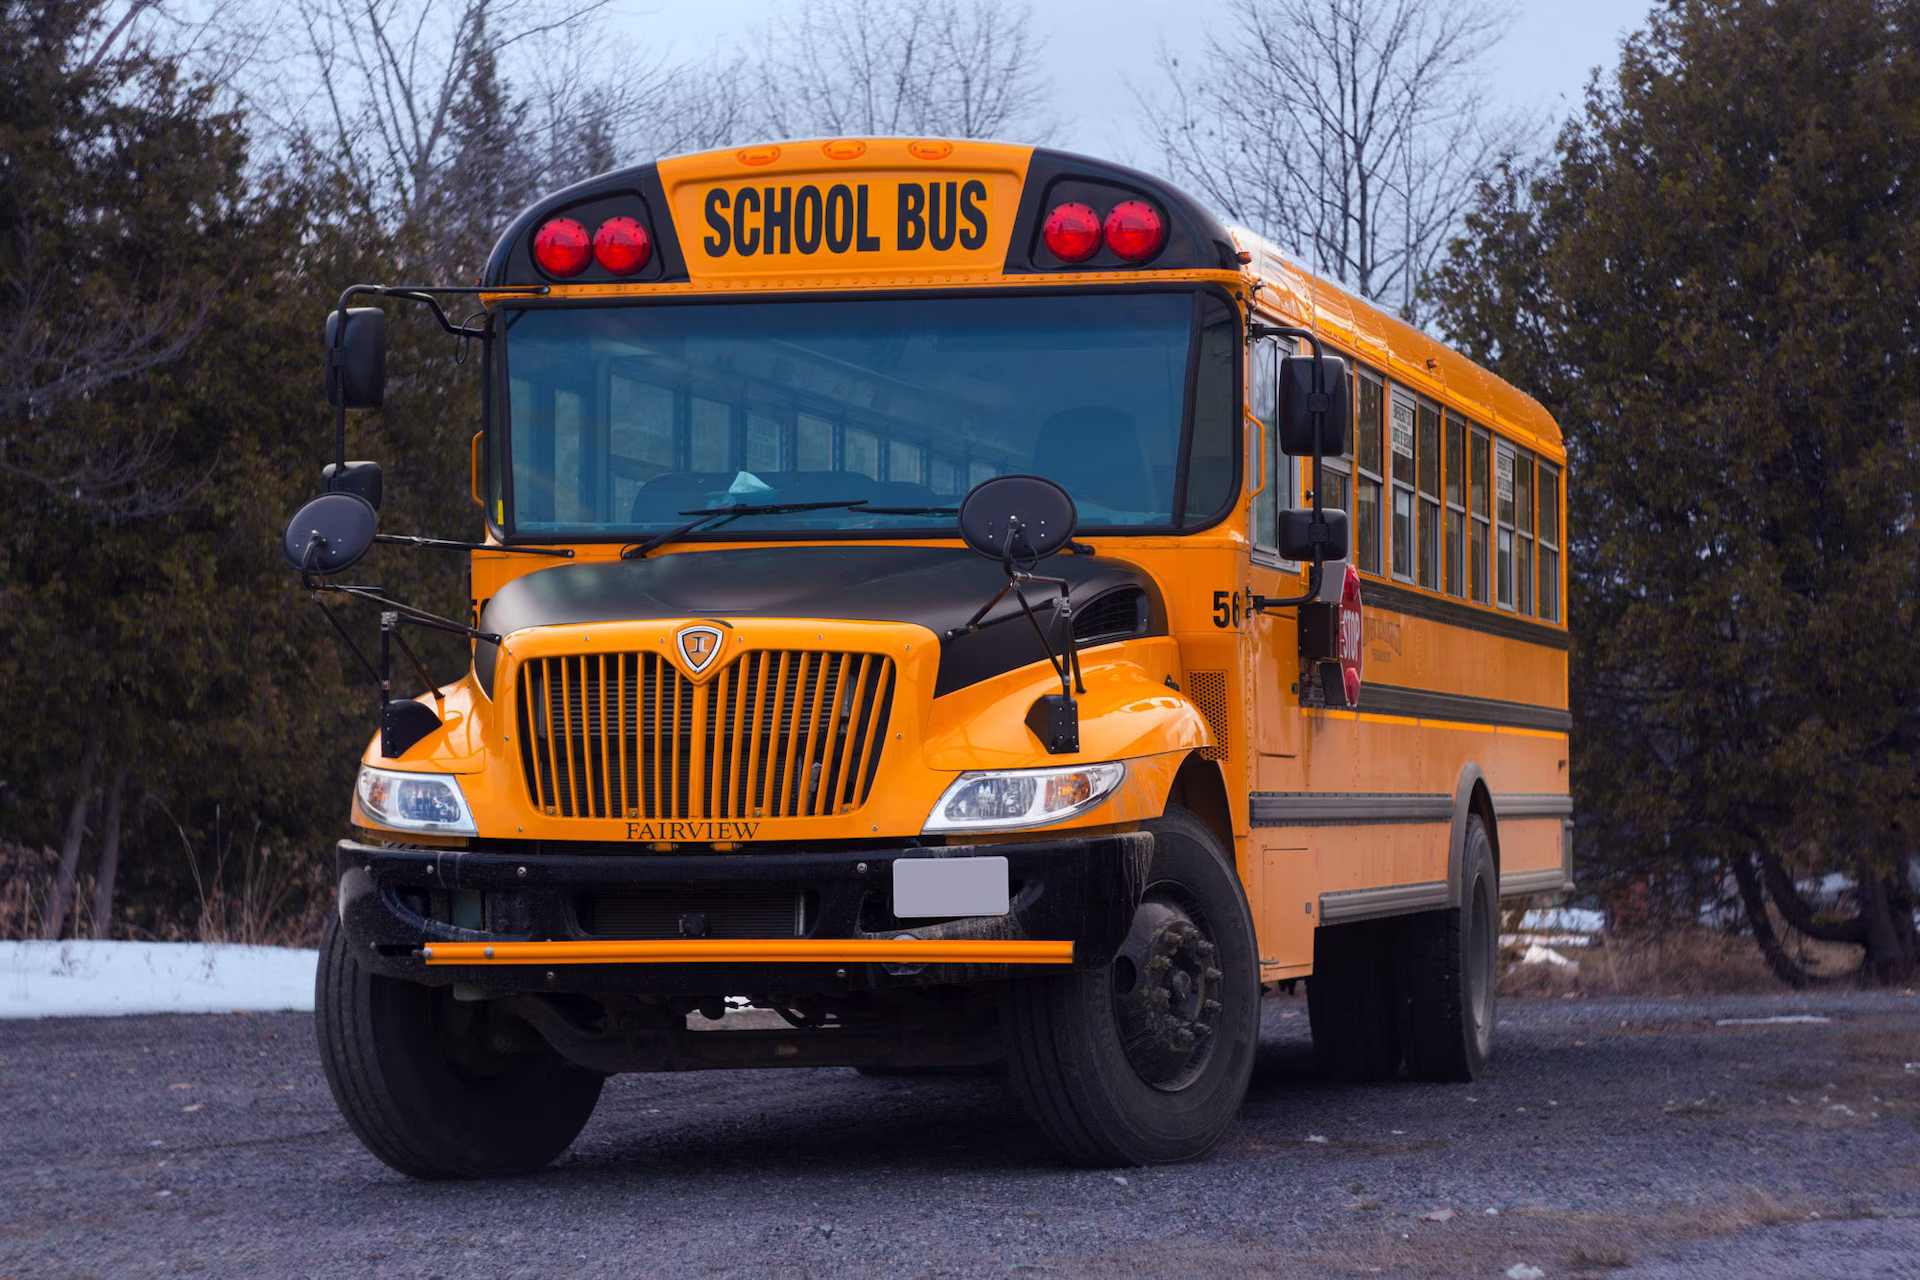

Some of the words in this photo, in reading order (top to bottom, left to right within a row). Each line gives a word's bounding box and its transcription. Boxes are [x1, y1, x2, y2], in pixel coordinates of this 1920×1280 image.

[703, 184, 881, 258] SCHOOL
[896, 179, 988, 252] BUS
[1213, 591, 1240, 629] 56
[1342, 609, 1361, 662] STOP
[626, 822, 761, 840] FAIRVIEW
